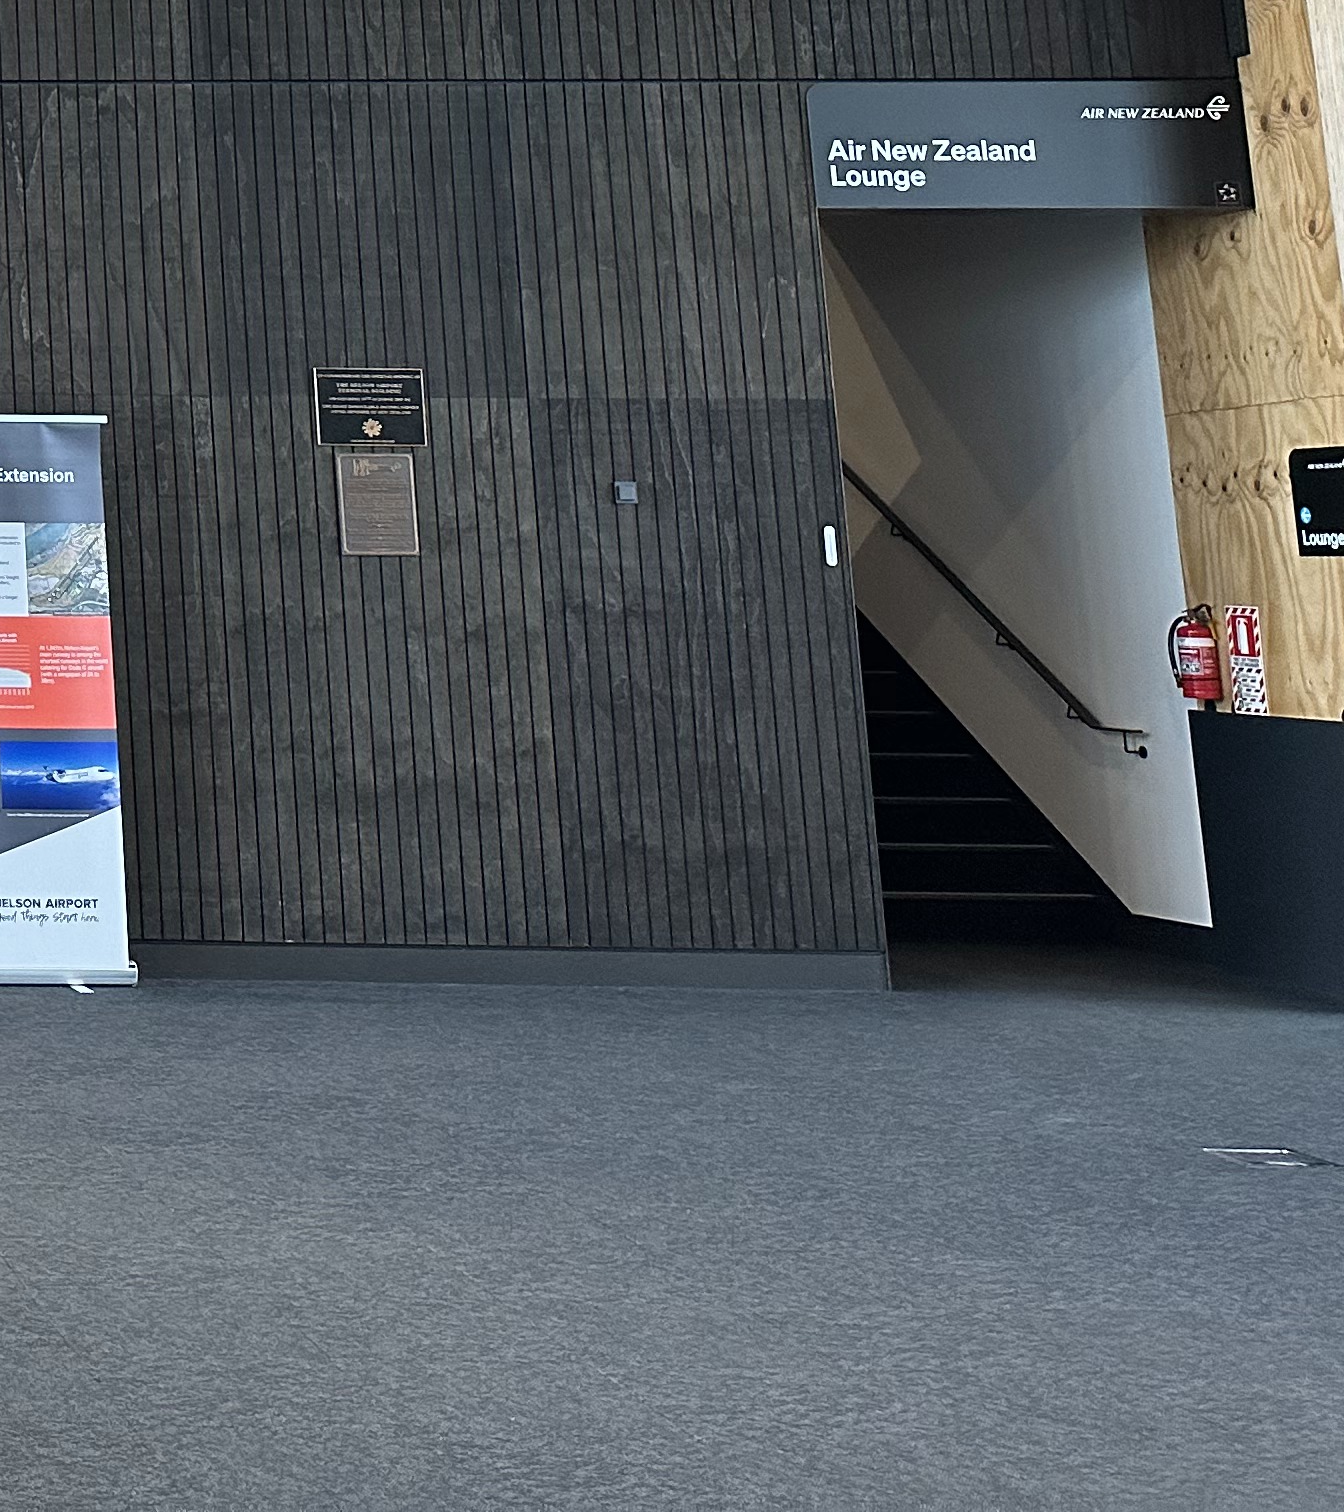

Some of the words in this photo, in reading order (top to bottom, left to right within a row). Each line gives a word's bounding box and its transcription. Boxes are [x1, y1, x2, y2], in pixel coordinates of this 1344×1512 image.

[1080, 107, 1105, 119] AIR
[1107, 107, 1139, 119] NEW
[1141, 107, 1205, 119] ZEALAND
[828, 139, 866, 162] Air
[871, 139, 928, 162] New
[932, 139, 1037, 162] Zealand
[829, 165, 926, 192] Lounge
[1301, 529, 1344, 550] Lounge
[45, 898, 99, 908] AIRPORT
